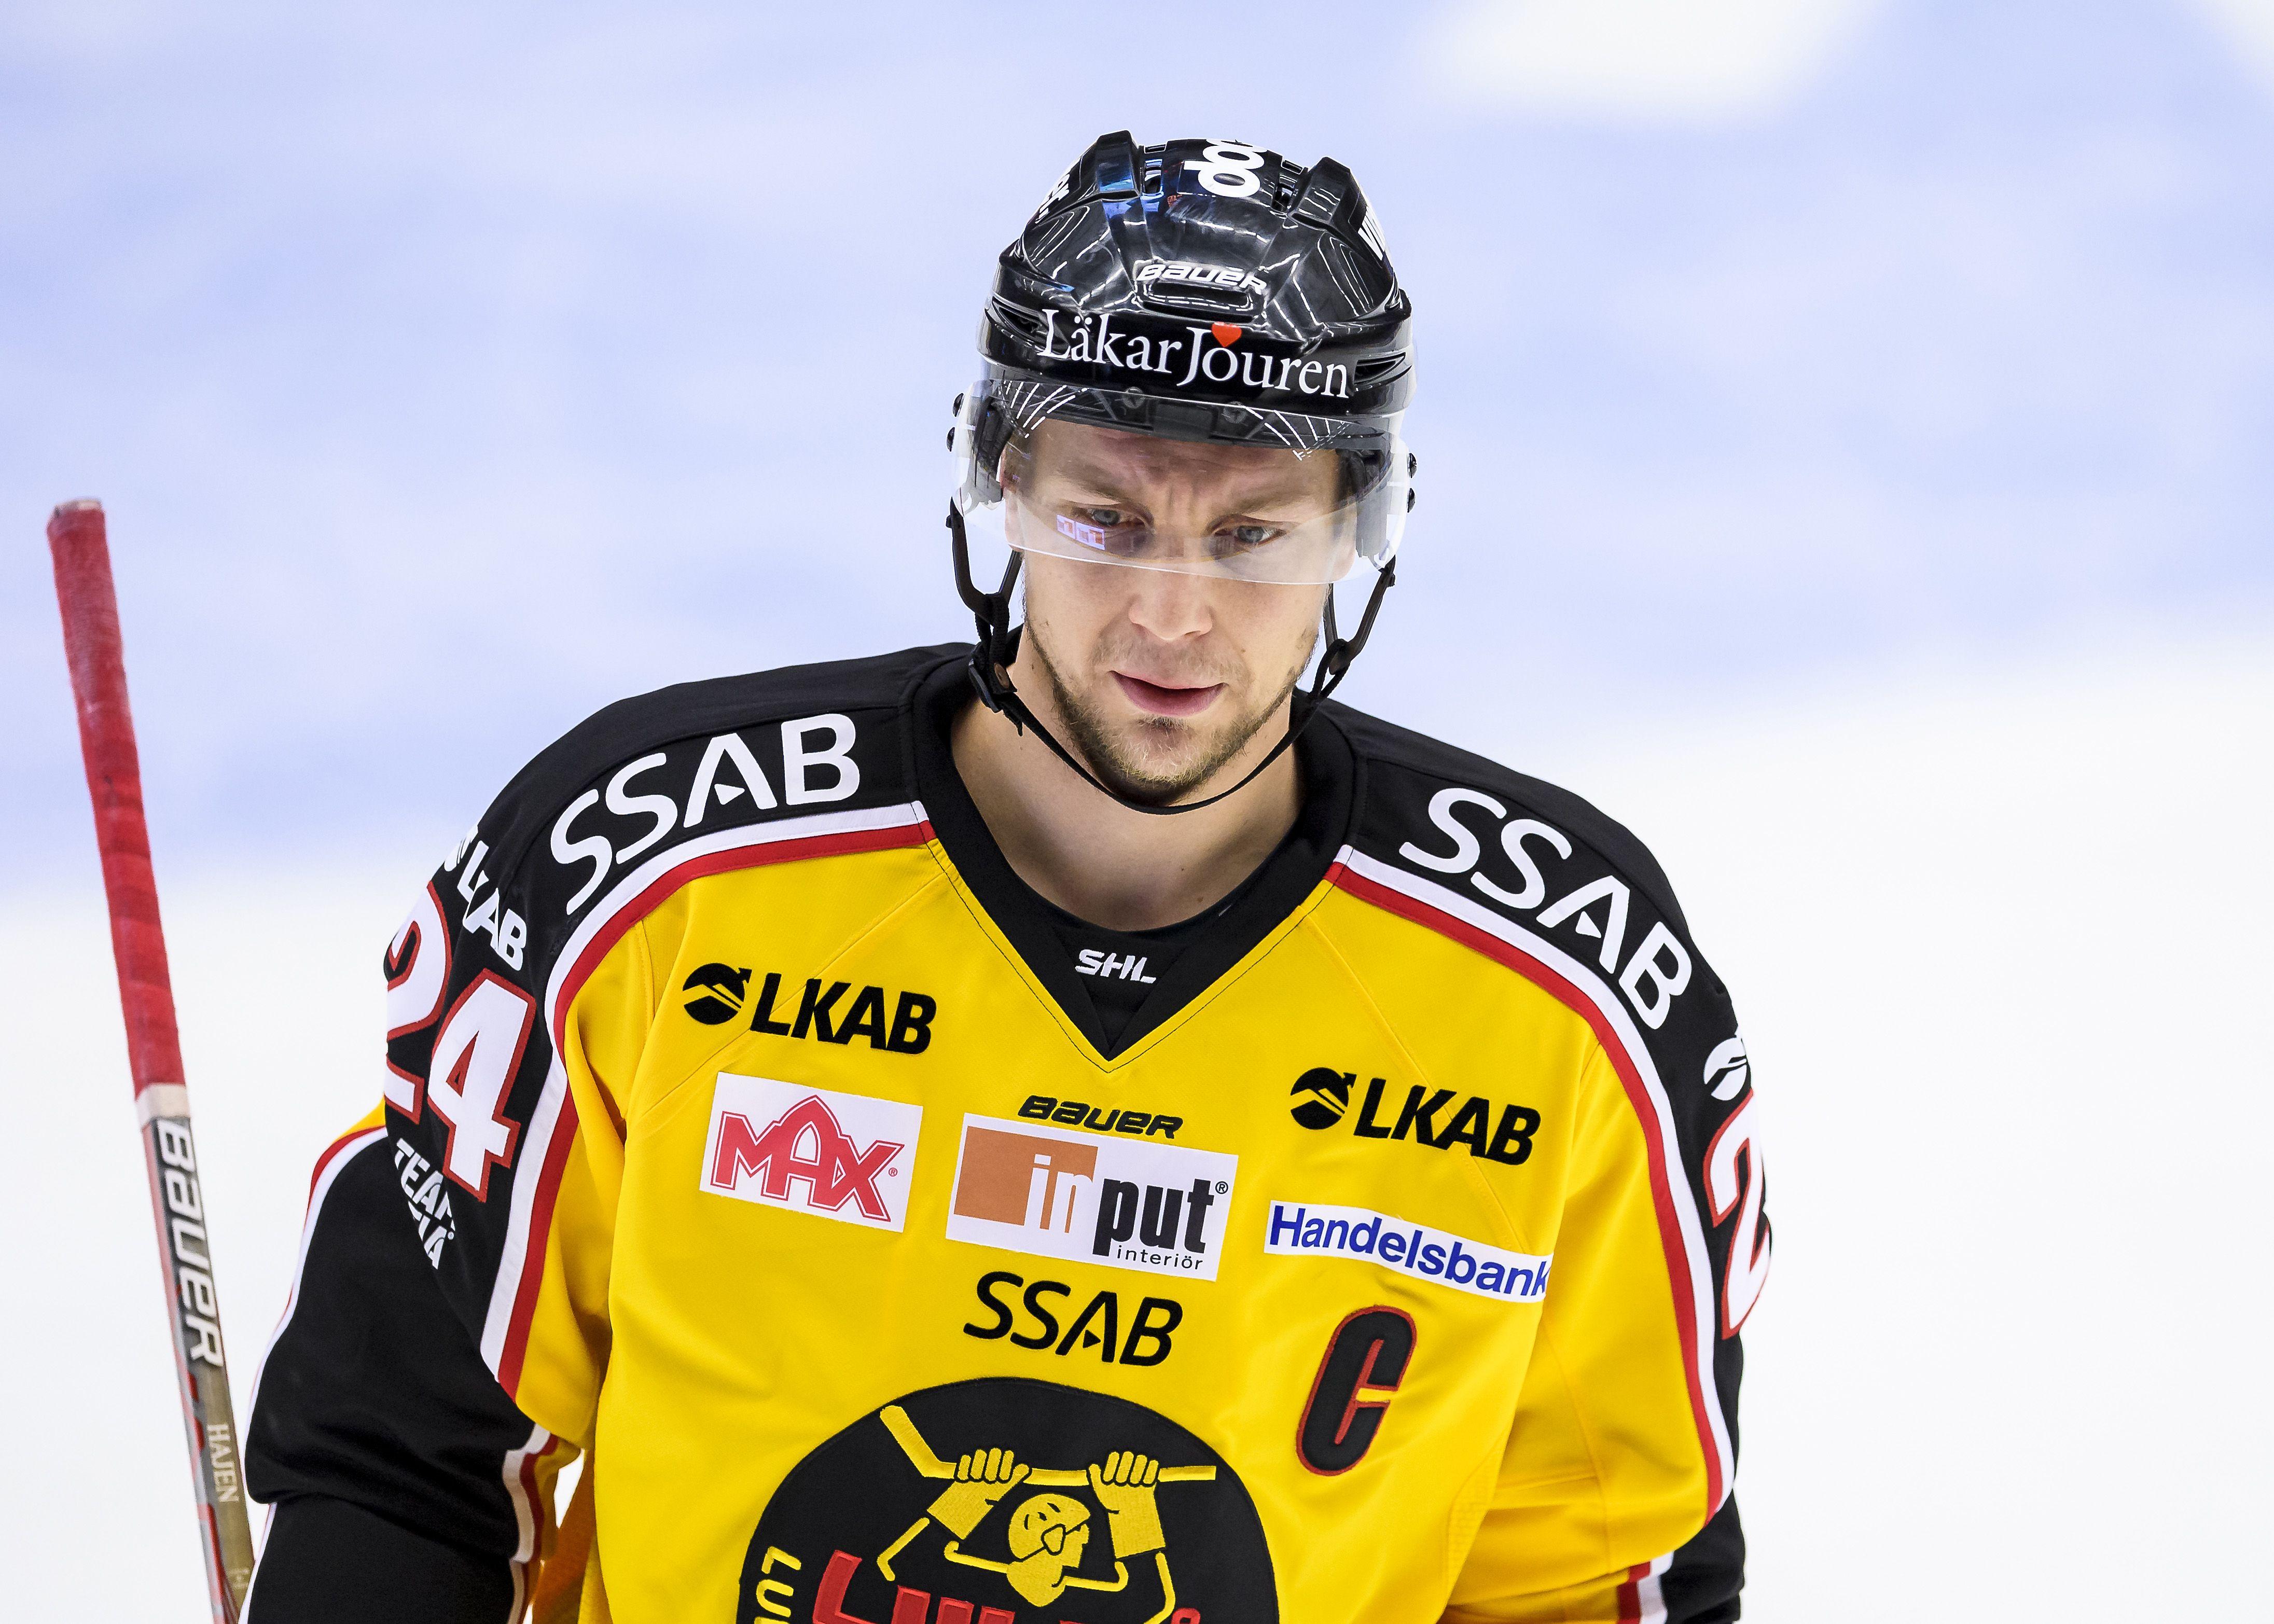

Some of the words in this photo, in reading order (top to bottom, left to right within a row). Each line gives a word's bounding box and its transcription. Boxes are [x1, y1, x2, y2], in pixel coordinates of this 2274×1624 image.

[1037, 309, 1350, 399] LäkarJouren
[550, 713, 860, 915] SSAB
[1399, 788, 1692, 1030] SSAB
[1075, 949, 1157, 983] SHL
[384, 881, 537, 1202] 24
[750, 973, 937, 1054] LKAB
[1018, 1095, 1184, 1140] BAUER
[1353, 1078, 1541, 1165] LKAB
[158, 1118, 225, 1367] BAUER
[1117, 1245, 1203, 1270] interiör
[963, 1271, 1183, 1367] SSAB
[1295, 1305, 1418, 1477] C
[207, 1422, 240, 1503] HAJEN
[754, 1546, 802, 1624] LU
